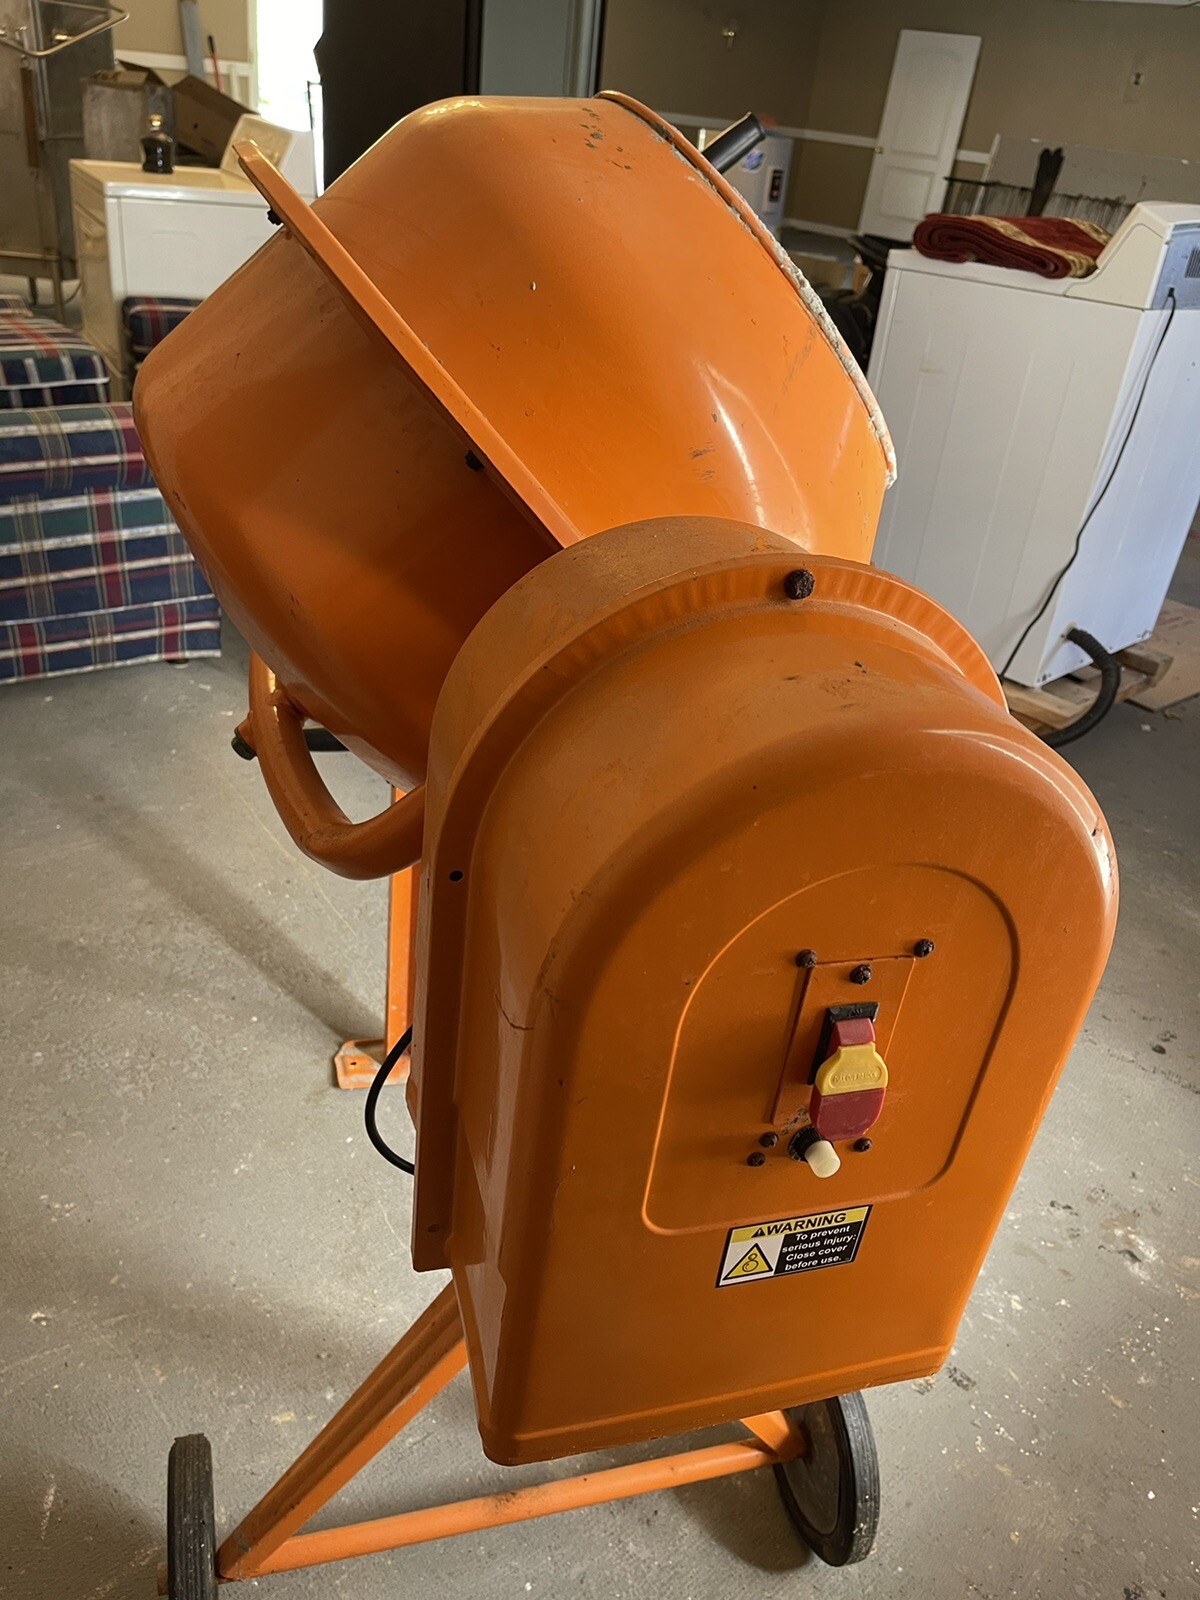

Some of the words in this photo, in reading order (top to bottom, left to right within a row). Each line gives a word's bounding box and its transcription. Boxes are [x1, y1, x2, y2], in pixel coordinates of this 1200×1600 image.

[766, 1213, 847, 1236] WARNING
[795, 1233, 808, 1241] To
[810, 1225, 851, 1240] prevent
[782, 1241, 821, 1253] serious
[786, 1250, 816, 1261] Close
[818, 1245, 848, 1256] cover
[784, 1259, 818, 1271] before
[820, 1255, 842, 1264] use.
